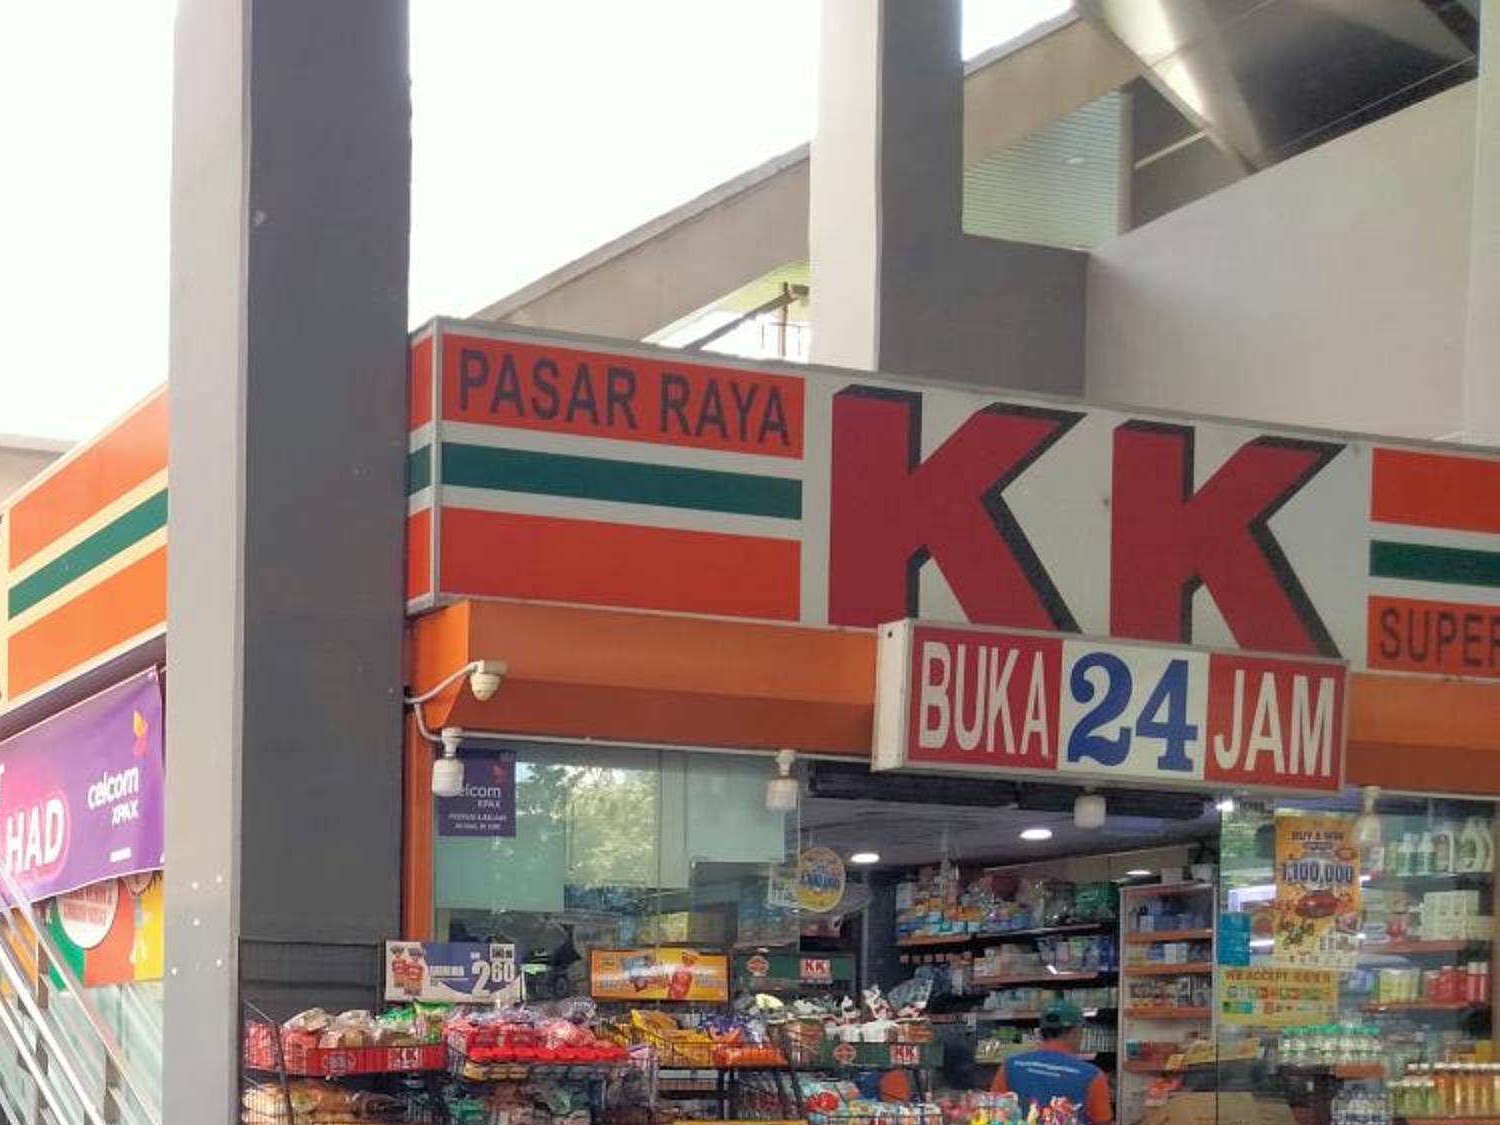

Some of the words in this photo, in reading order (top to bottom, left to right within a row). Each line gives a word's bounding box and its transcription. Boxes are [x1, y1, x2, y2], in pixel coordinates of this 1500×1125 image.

[458, 349, 638, 430] PASAR
[660, 372, 791, 447] RAYA
[918, 640, 1050, 757] BUKA
[1066, 651, 1198, 773] 24
[1213, 669, 1336, 778] JAM
[88, 767, 139, 810] celcom
[4, 798, 65, 878] HAD
